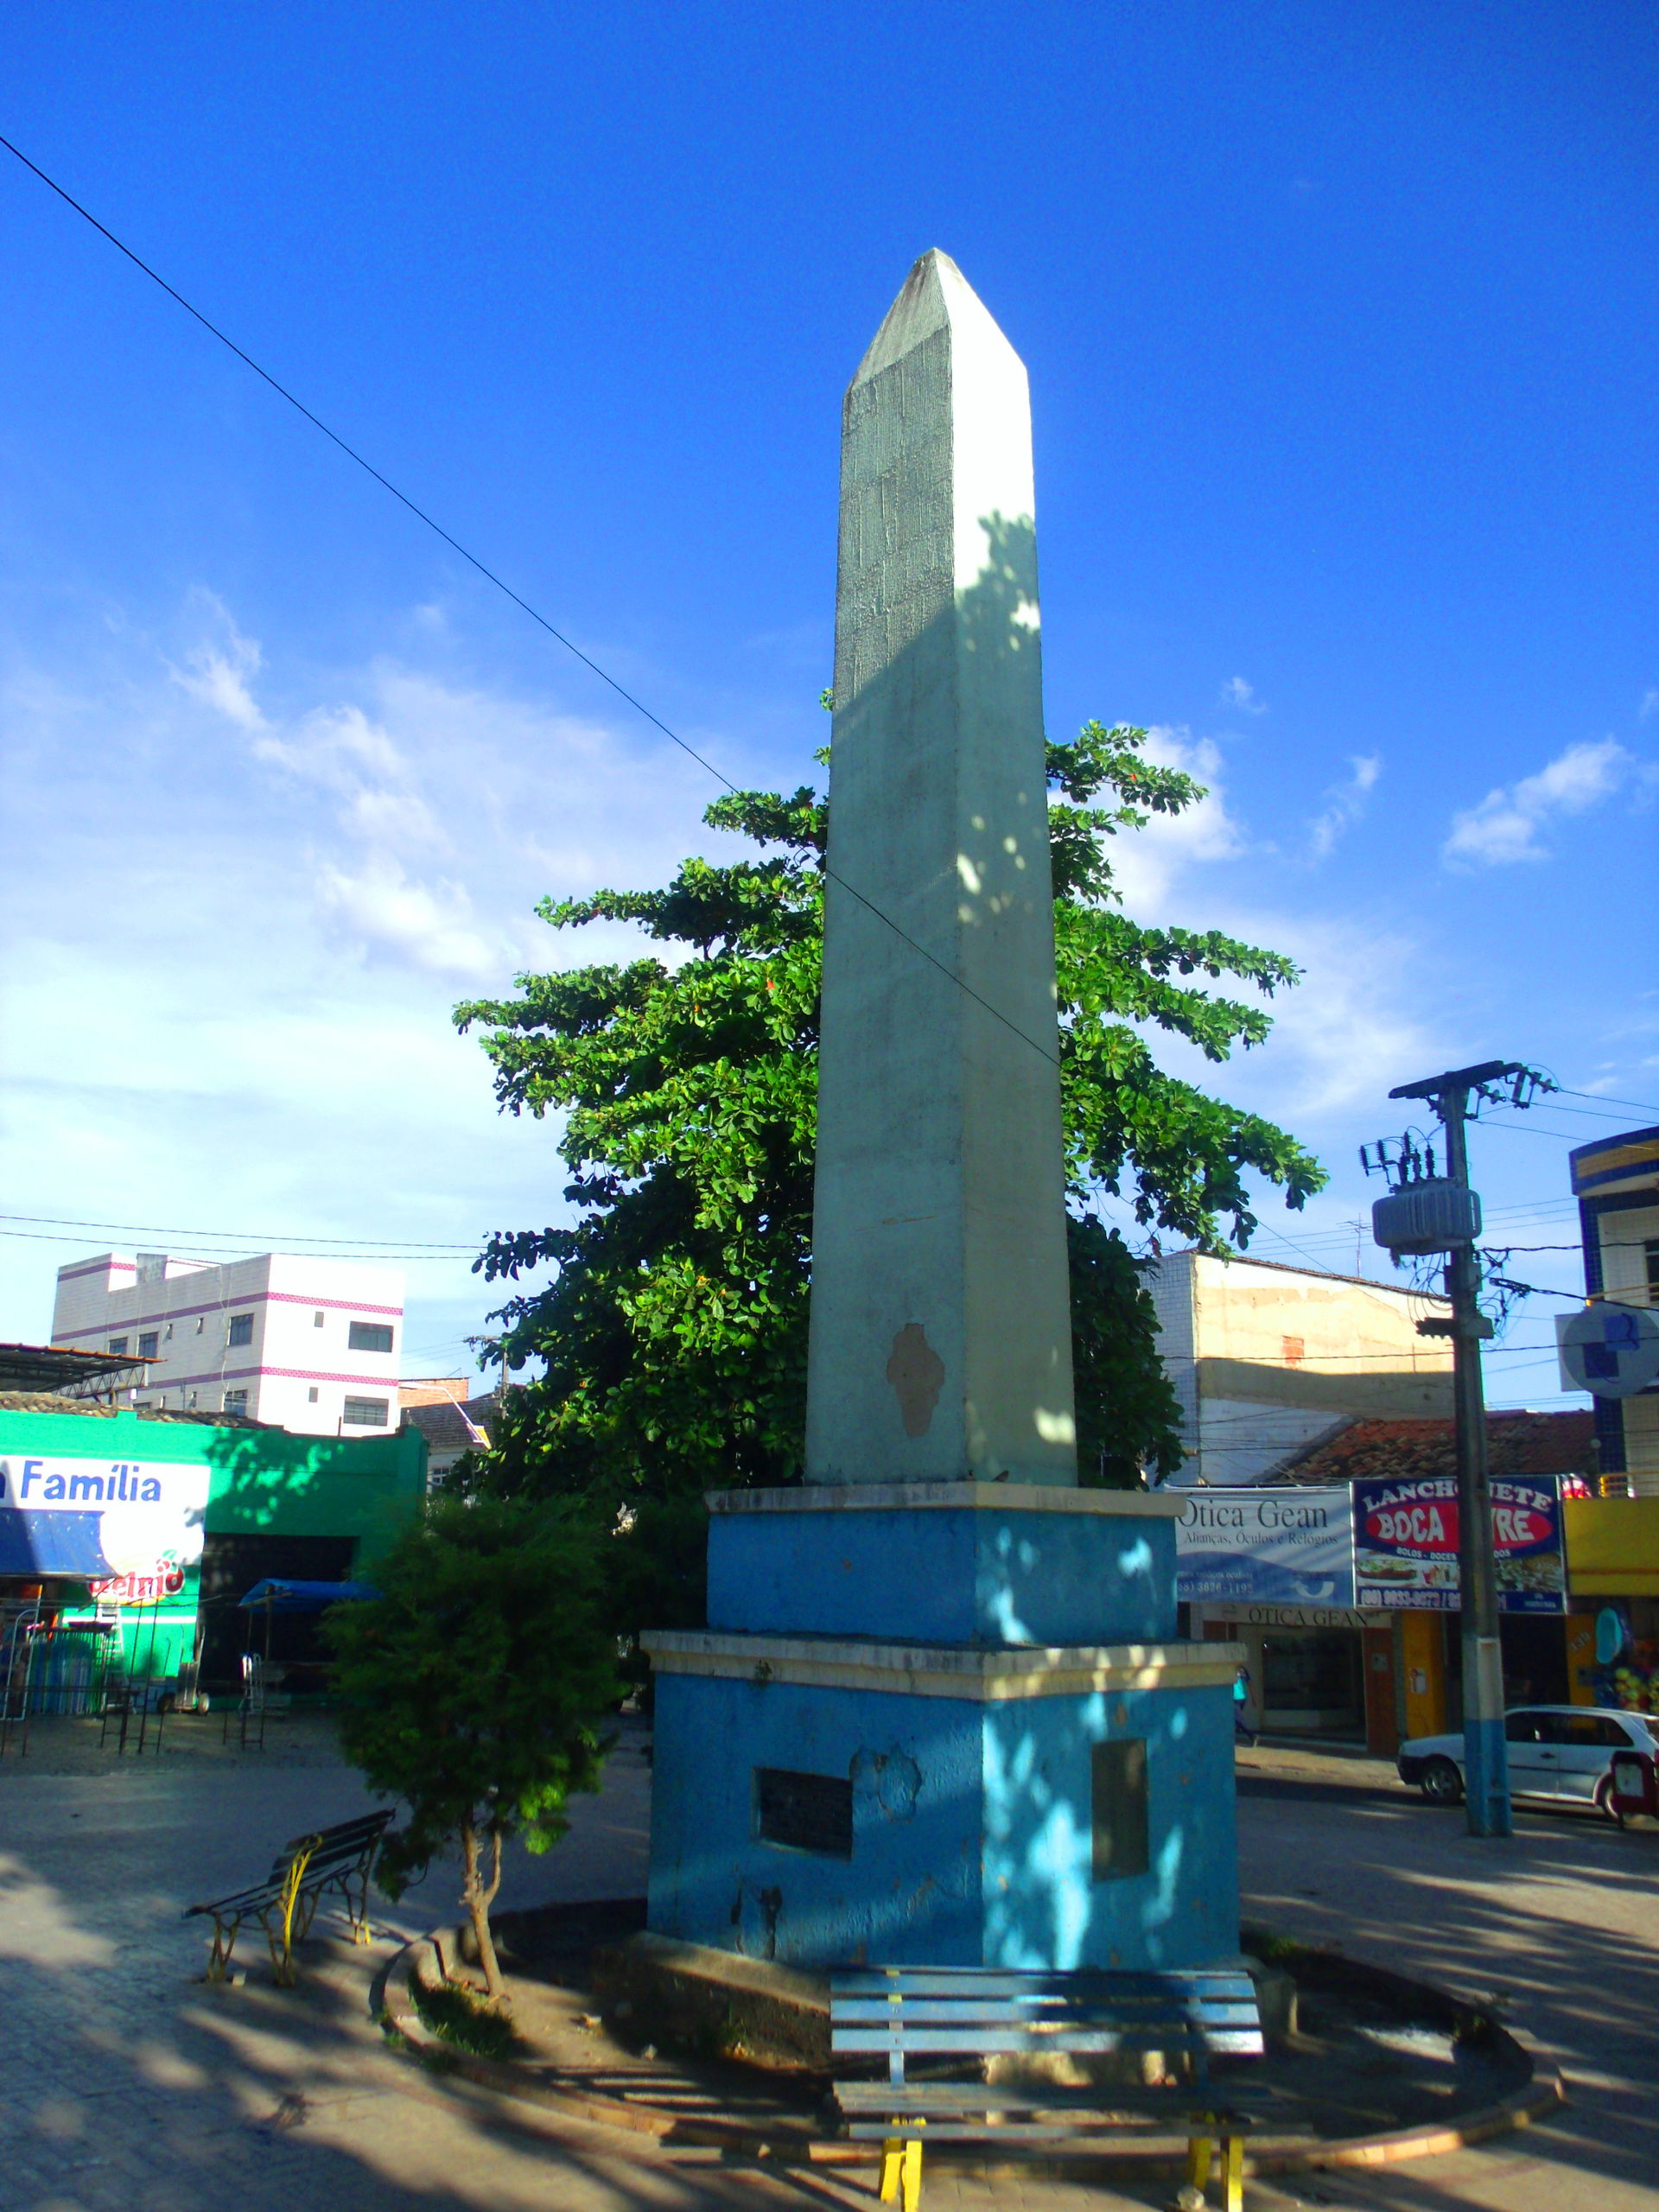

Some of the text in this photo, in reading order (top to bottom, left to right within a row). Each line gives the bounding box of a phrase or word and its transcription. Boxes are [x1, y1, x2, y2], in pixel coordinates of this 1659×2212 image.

[21, 1459, 162, 1501] Família
[1362, 1480, 1554, 1512] LANCHETE
[1257, 1499, 1328, 1528] Gean
[1376, 1506, 1445, 1542] BOCA
[1184, 1532, 1232, 1546] Alianças,
[1236, 1530, 1274, 1544] Óculos
[1287, 1531, 1338, 1548] Relógios
[1395, 1546, 1422, 1559] BOLOS
[1313, 1609, 1368, 1627] GEAN
